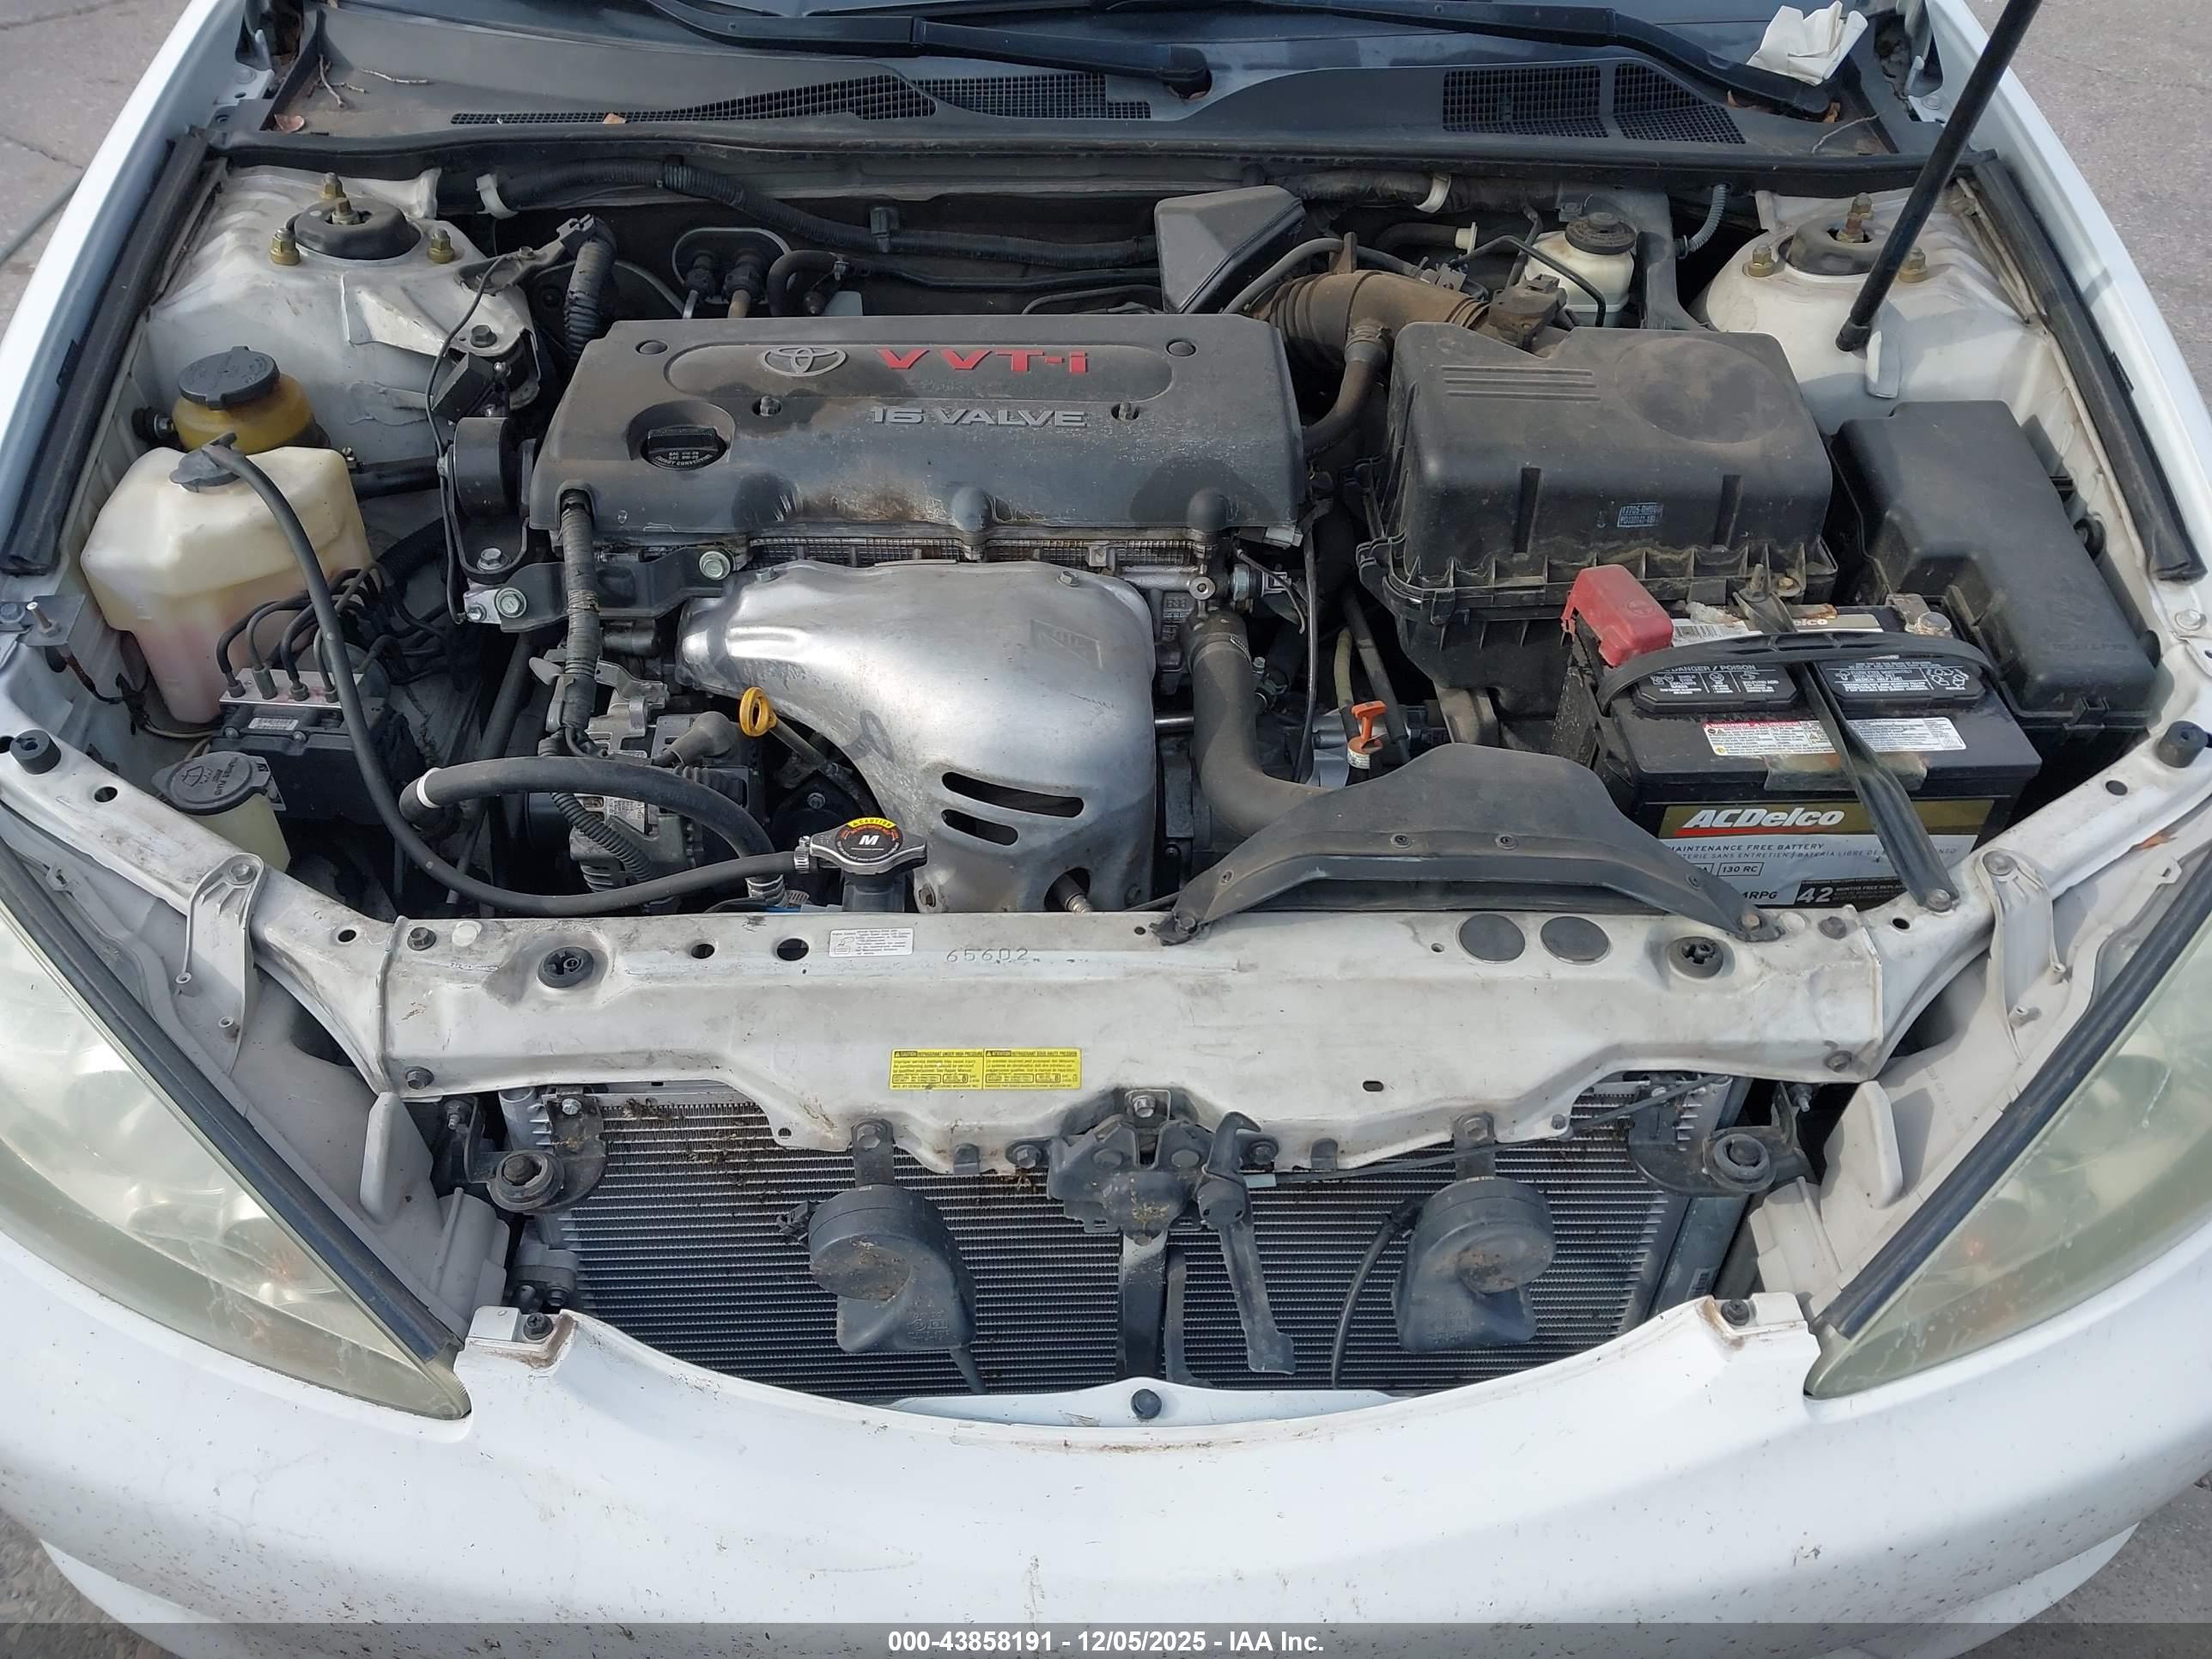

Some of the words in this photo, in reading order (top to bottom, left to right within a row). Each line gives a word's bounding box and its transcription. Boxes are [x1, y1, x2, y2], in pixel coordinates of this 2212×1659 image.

[871, 406, 925, 423] 16
[933, 408, 1088, 428] VALVE
[1682, 807, 1845, 829] ACDelco
[1796, 886, 1834, 903] 42
